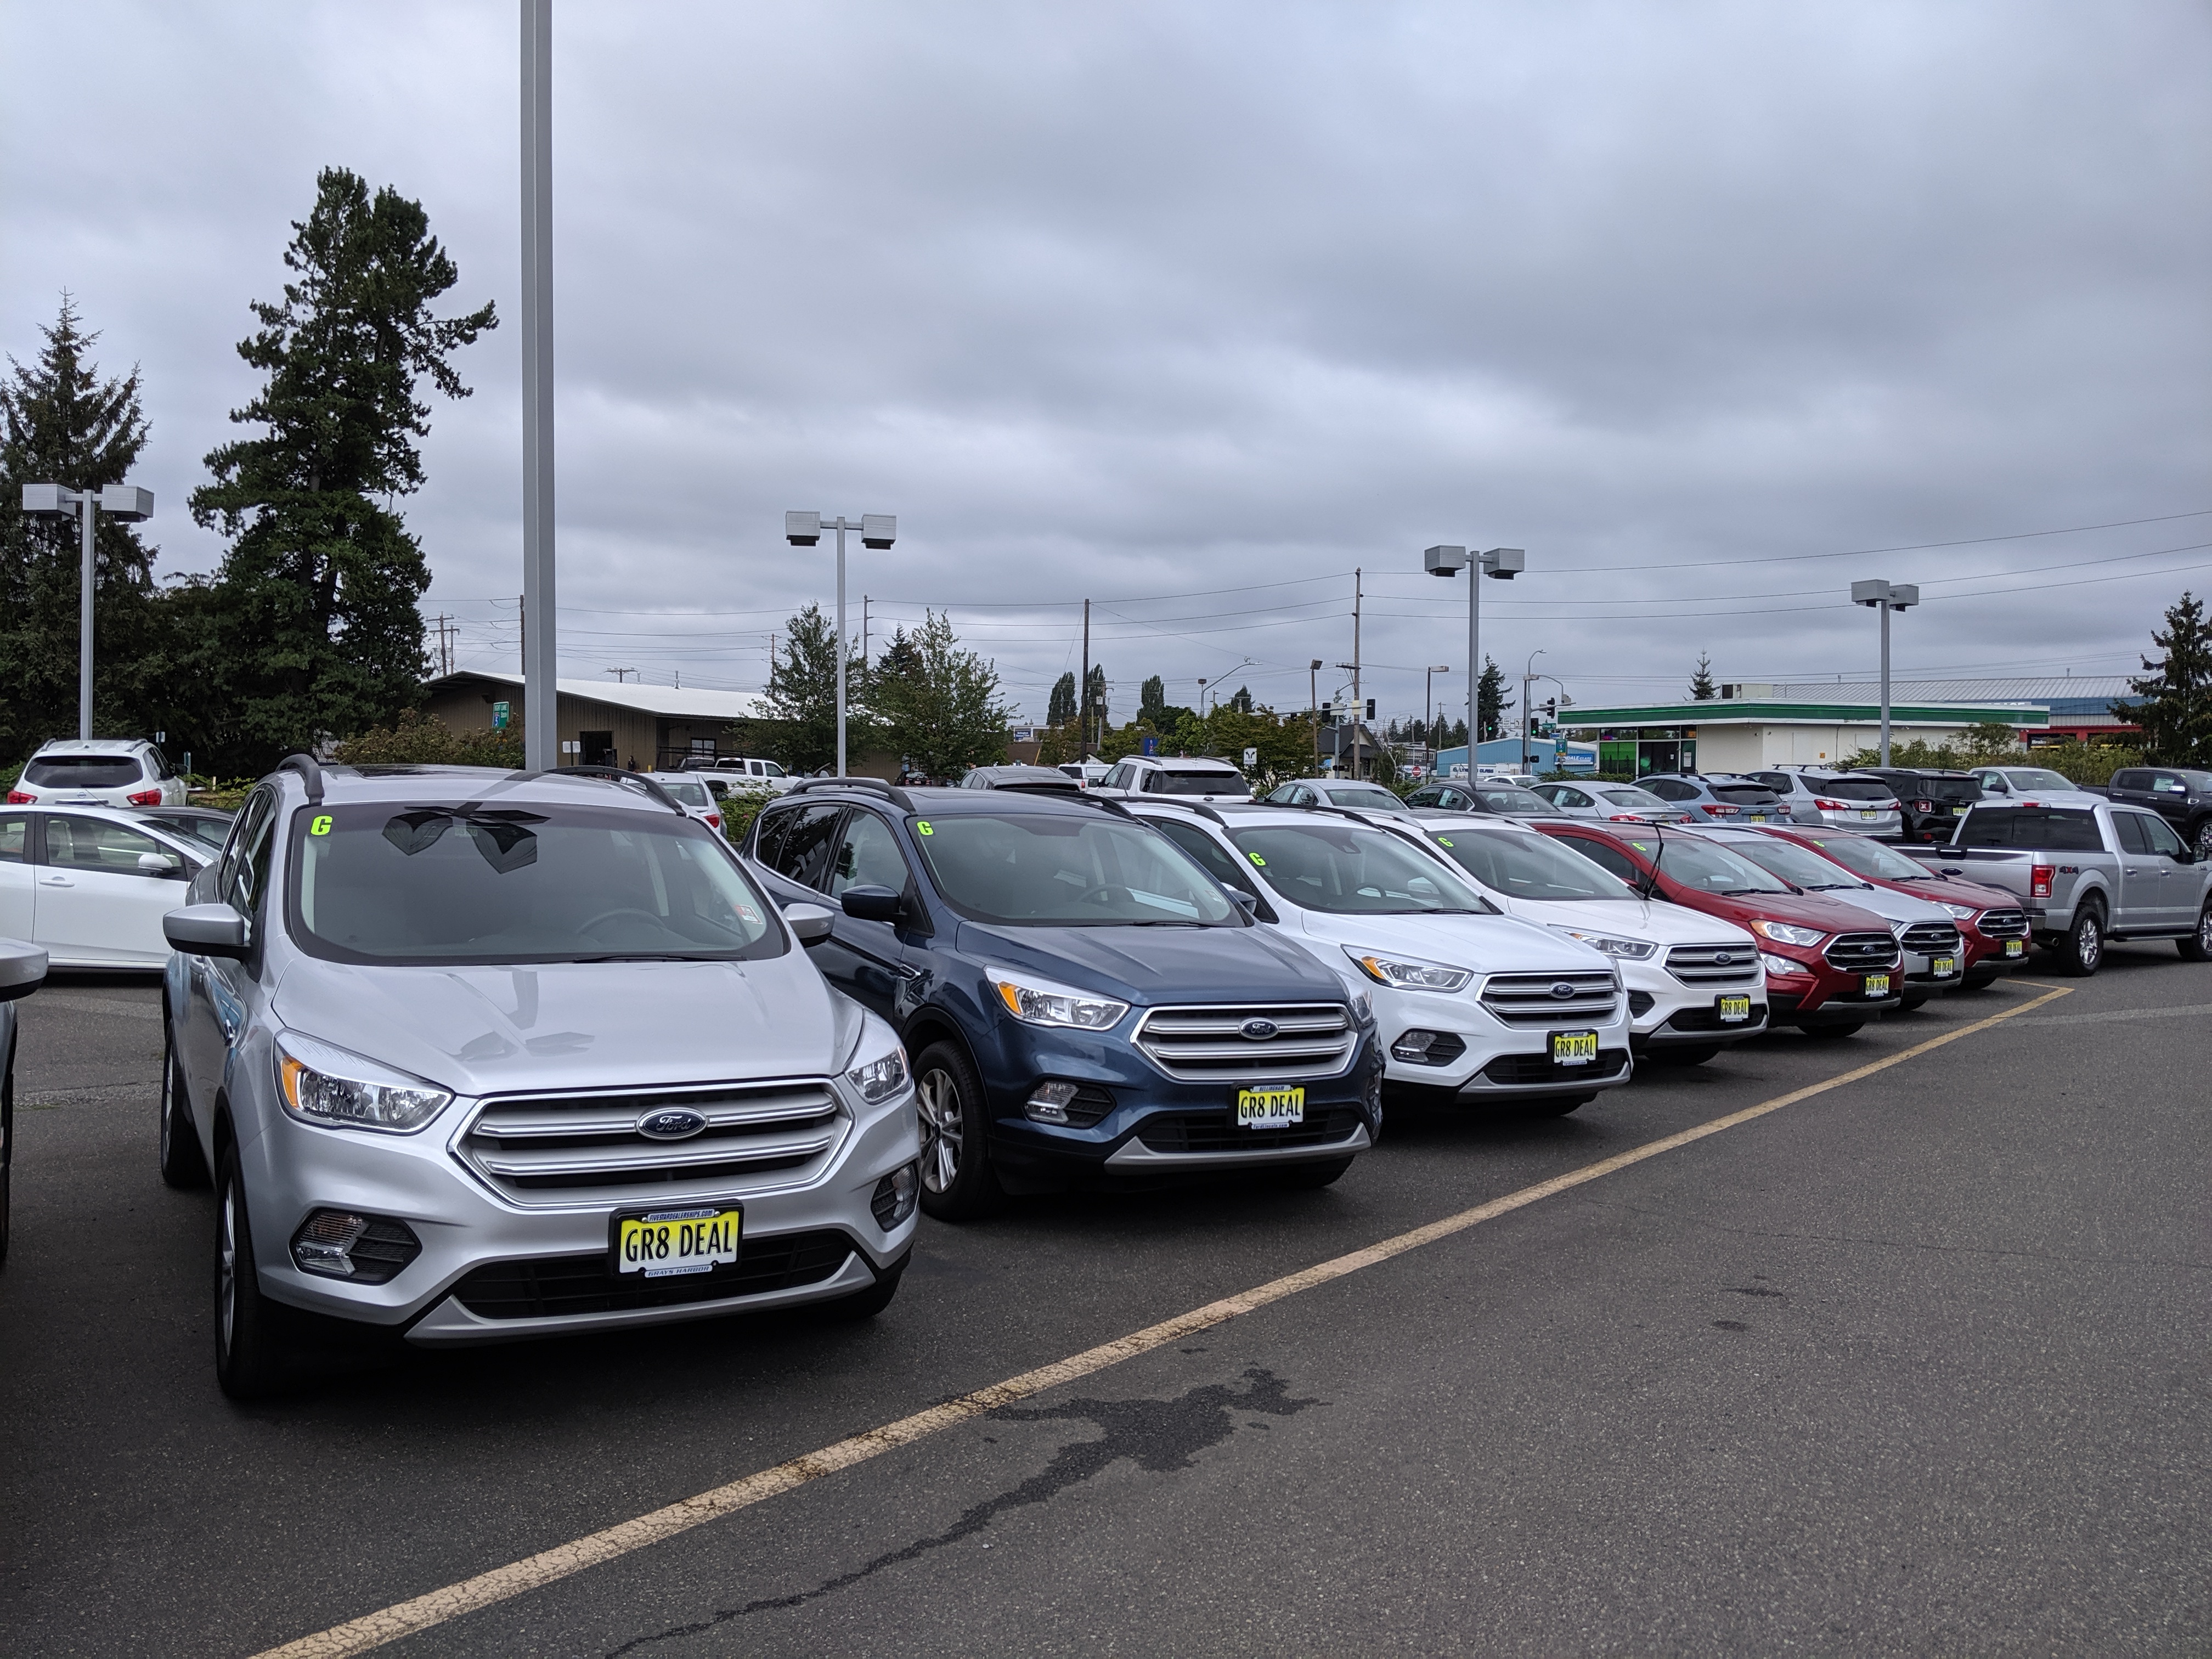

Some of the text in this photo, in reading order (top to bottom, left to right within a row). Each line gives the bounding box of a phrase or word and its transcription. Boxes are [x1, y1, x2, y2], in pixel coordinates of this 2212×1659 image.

[311, 815, 333, 836] G
[917, 821, 934, 836] G
[1249, 852, 1266, 866] G
[1943, 962, 1951, 972] DEAL
[1866, 979, 1887, 991] GR8 DEAL
[1721, 1001, 1747, 1015] GR8 DEAL
[1555, 1039, 1594, 1058] GR8 DEAL
[1240, 1094, 1300, 1118] GR8 DEAL
[656, 1115, 691, 1131] Ford
[649, 1210, 713, 1222] FIVESTARDEALERSHIPS.COM
[625, 1221, 733, 1263] GR8 DEAL
